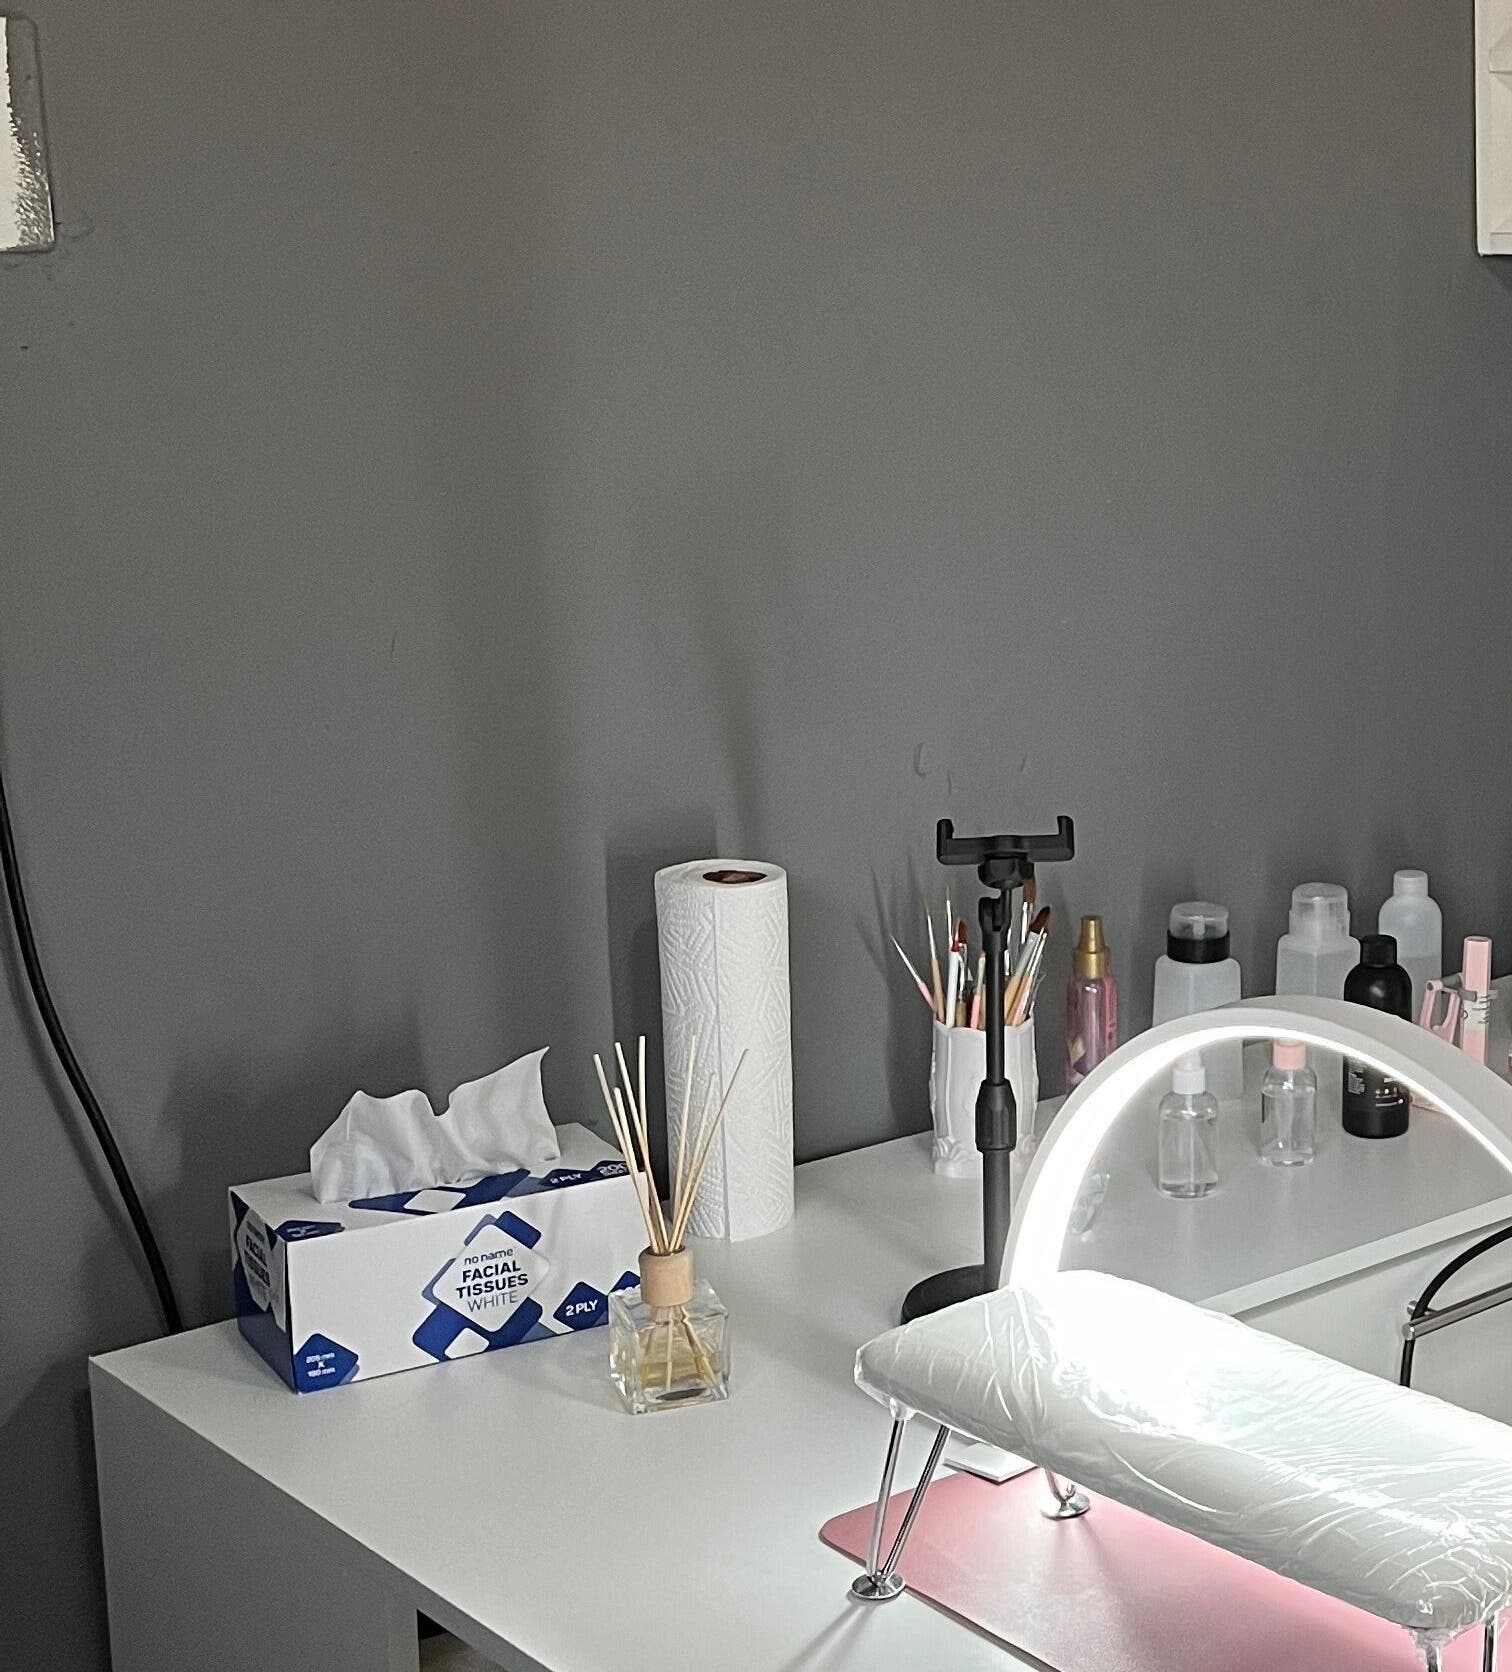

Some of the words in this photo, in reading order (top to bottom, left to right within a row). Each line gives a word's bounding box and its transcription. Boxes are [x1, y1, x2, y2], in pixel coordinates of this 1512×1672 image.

[464, 1256, 479, 1266] no
[480, 1248, 514, 1262] name
[462, 1260, 522, 1283] FACIAL
[456, 1273, 529, 1299] TISSUES
[467, 1290, 519, 1313] WHITE
[565, 1305, 574, 1317] 2
[575, 1299, 598, 1314] PLY
